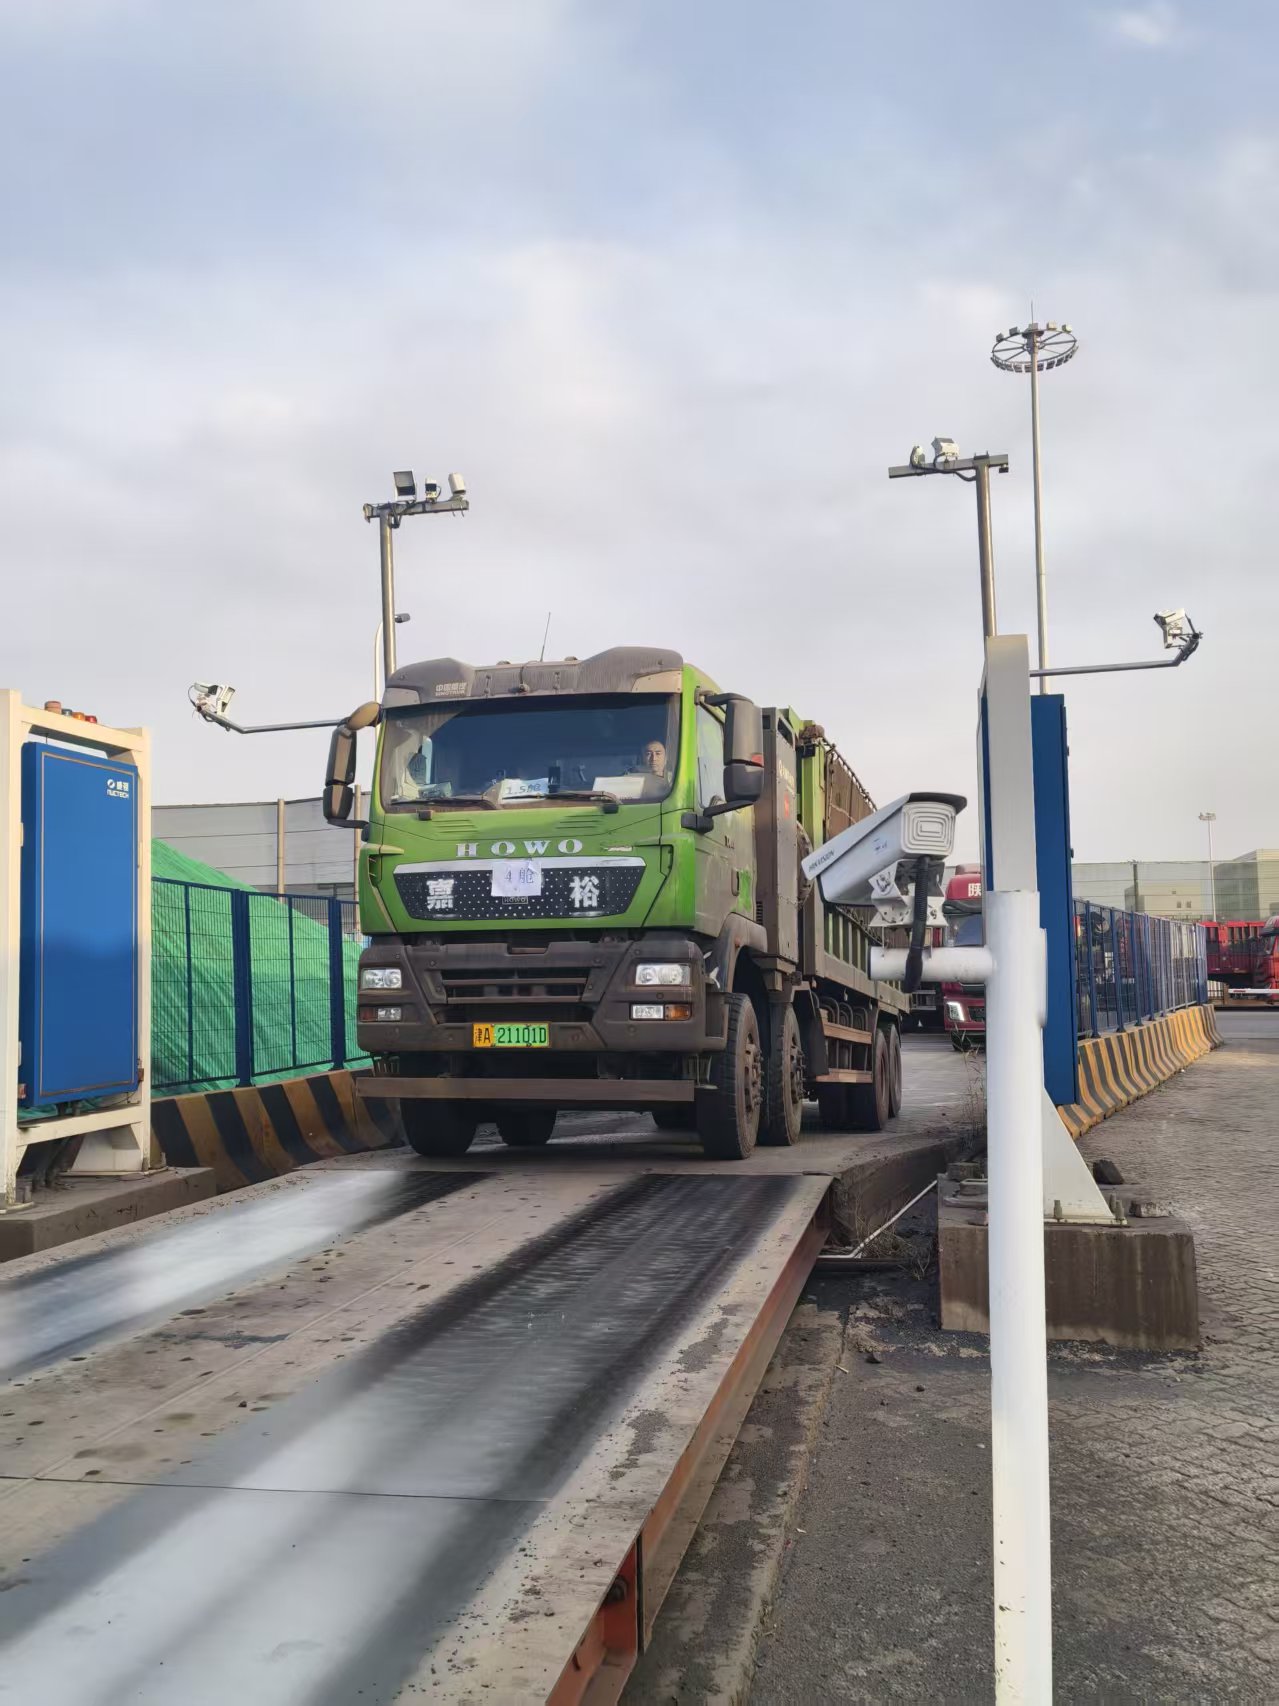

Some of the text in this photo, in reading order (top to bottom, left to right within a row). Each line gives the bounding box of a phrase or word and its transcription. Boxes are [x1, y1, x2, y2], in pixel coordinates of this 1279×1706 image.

[456, 839, 583, 858] HOWO
[426, 876, 600, 910] 嘉 裕
